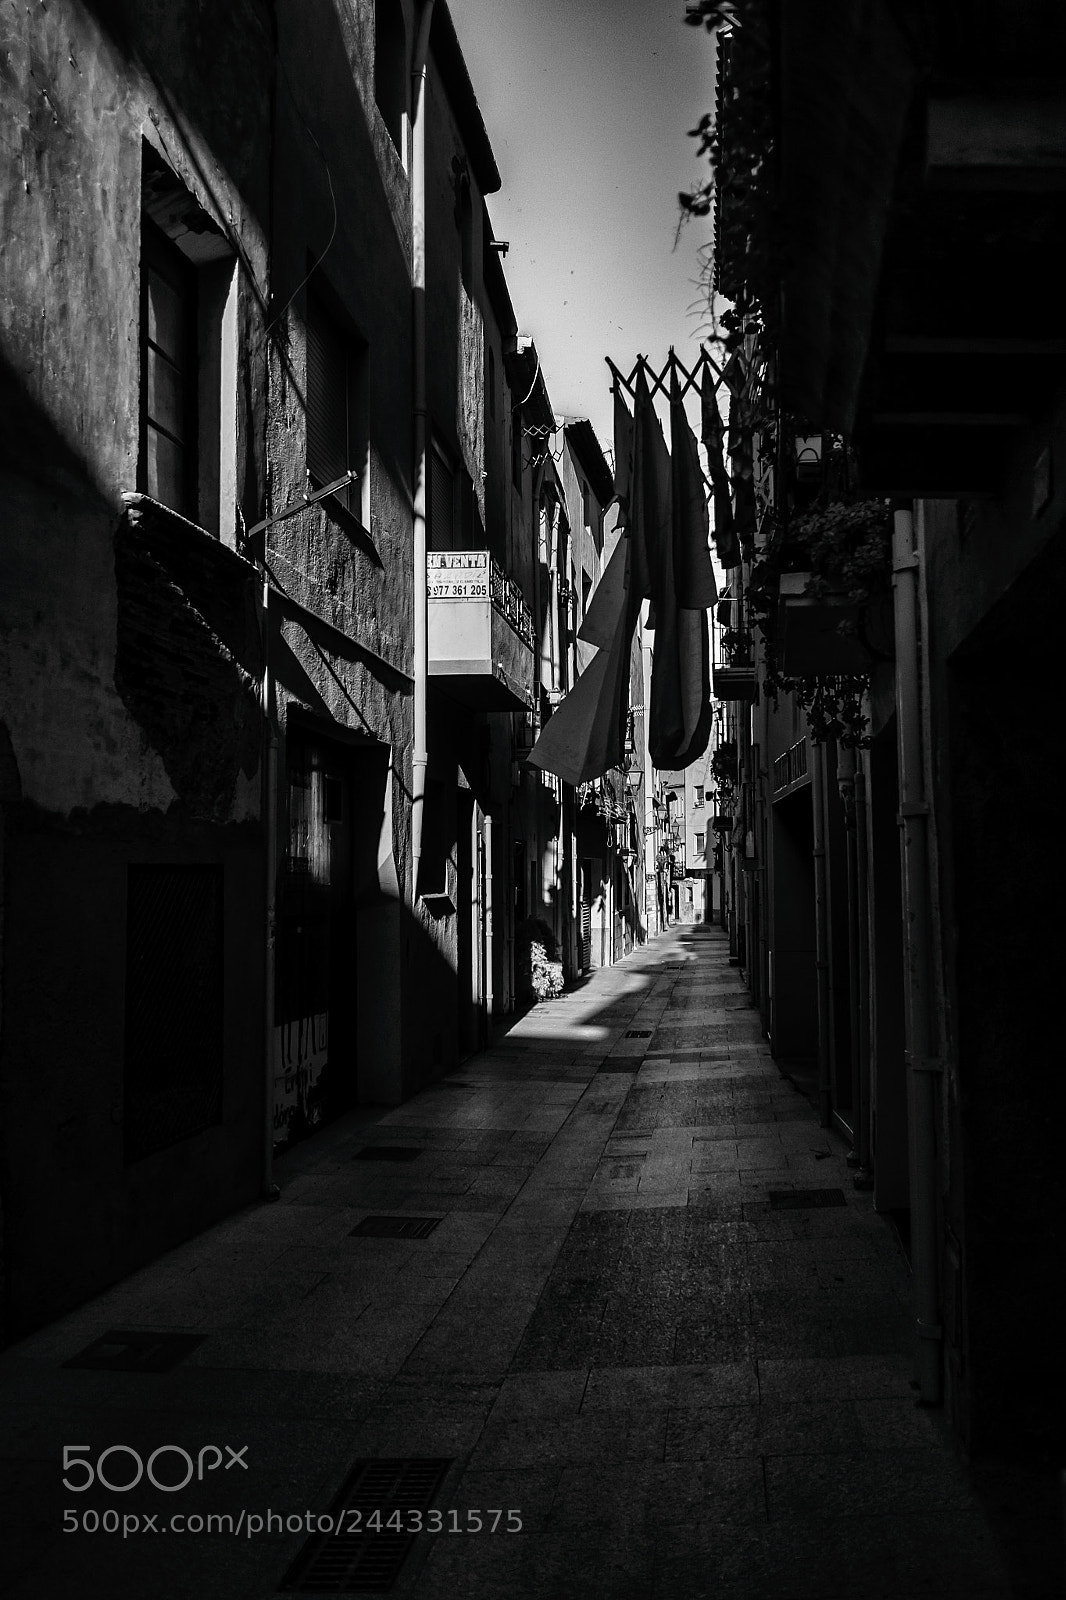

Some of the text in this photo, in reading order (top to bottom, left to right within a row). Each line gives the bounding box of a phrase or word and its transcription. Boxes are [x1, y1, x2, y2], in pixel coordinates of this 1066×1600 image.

[445, 554, 486, 568] VENTA
[433, 584, 487, 596] 977 361 205
